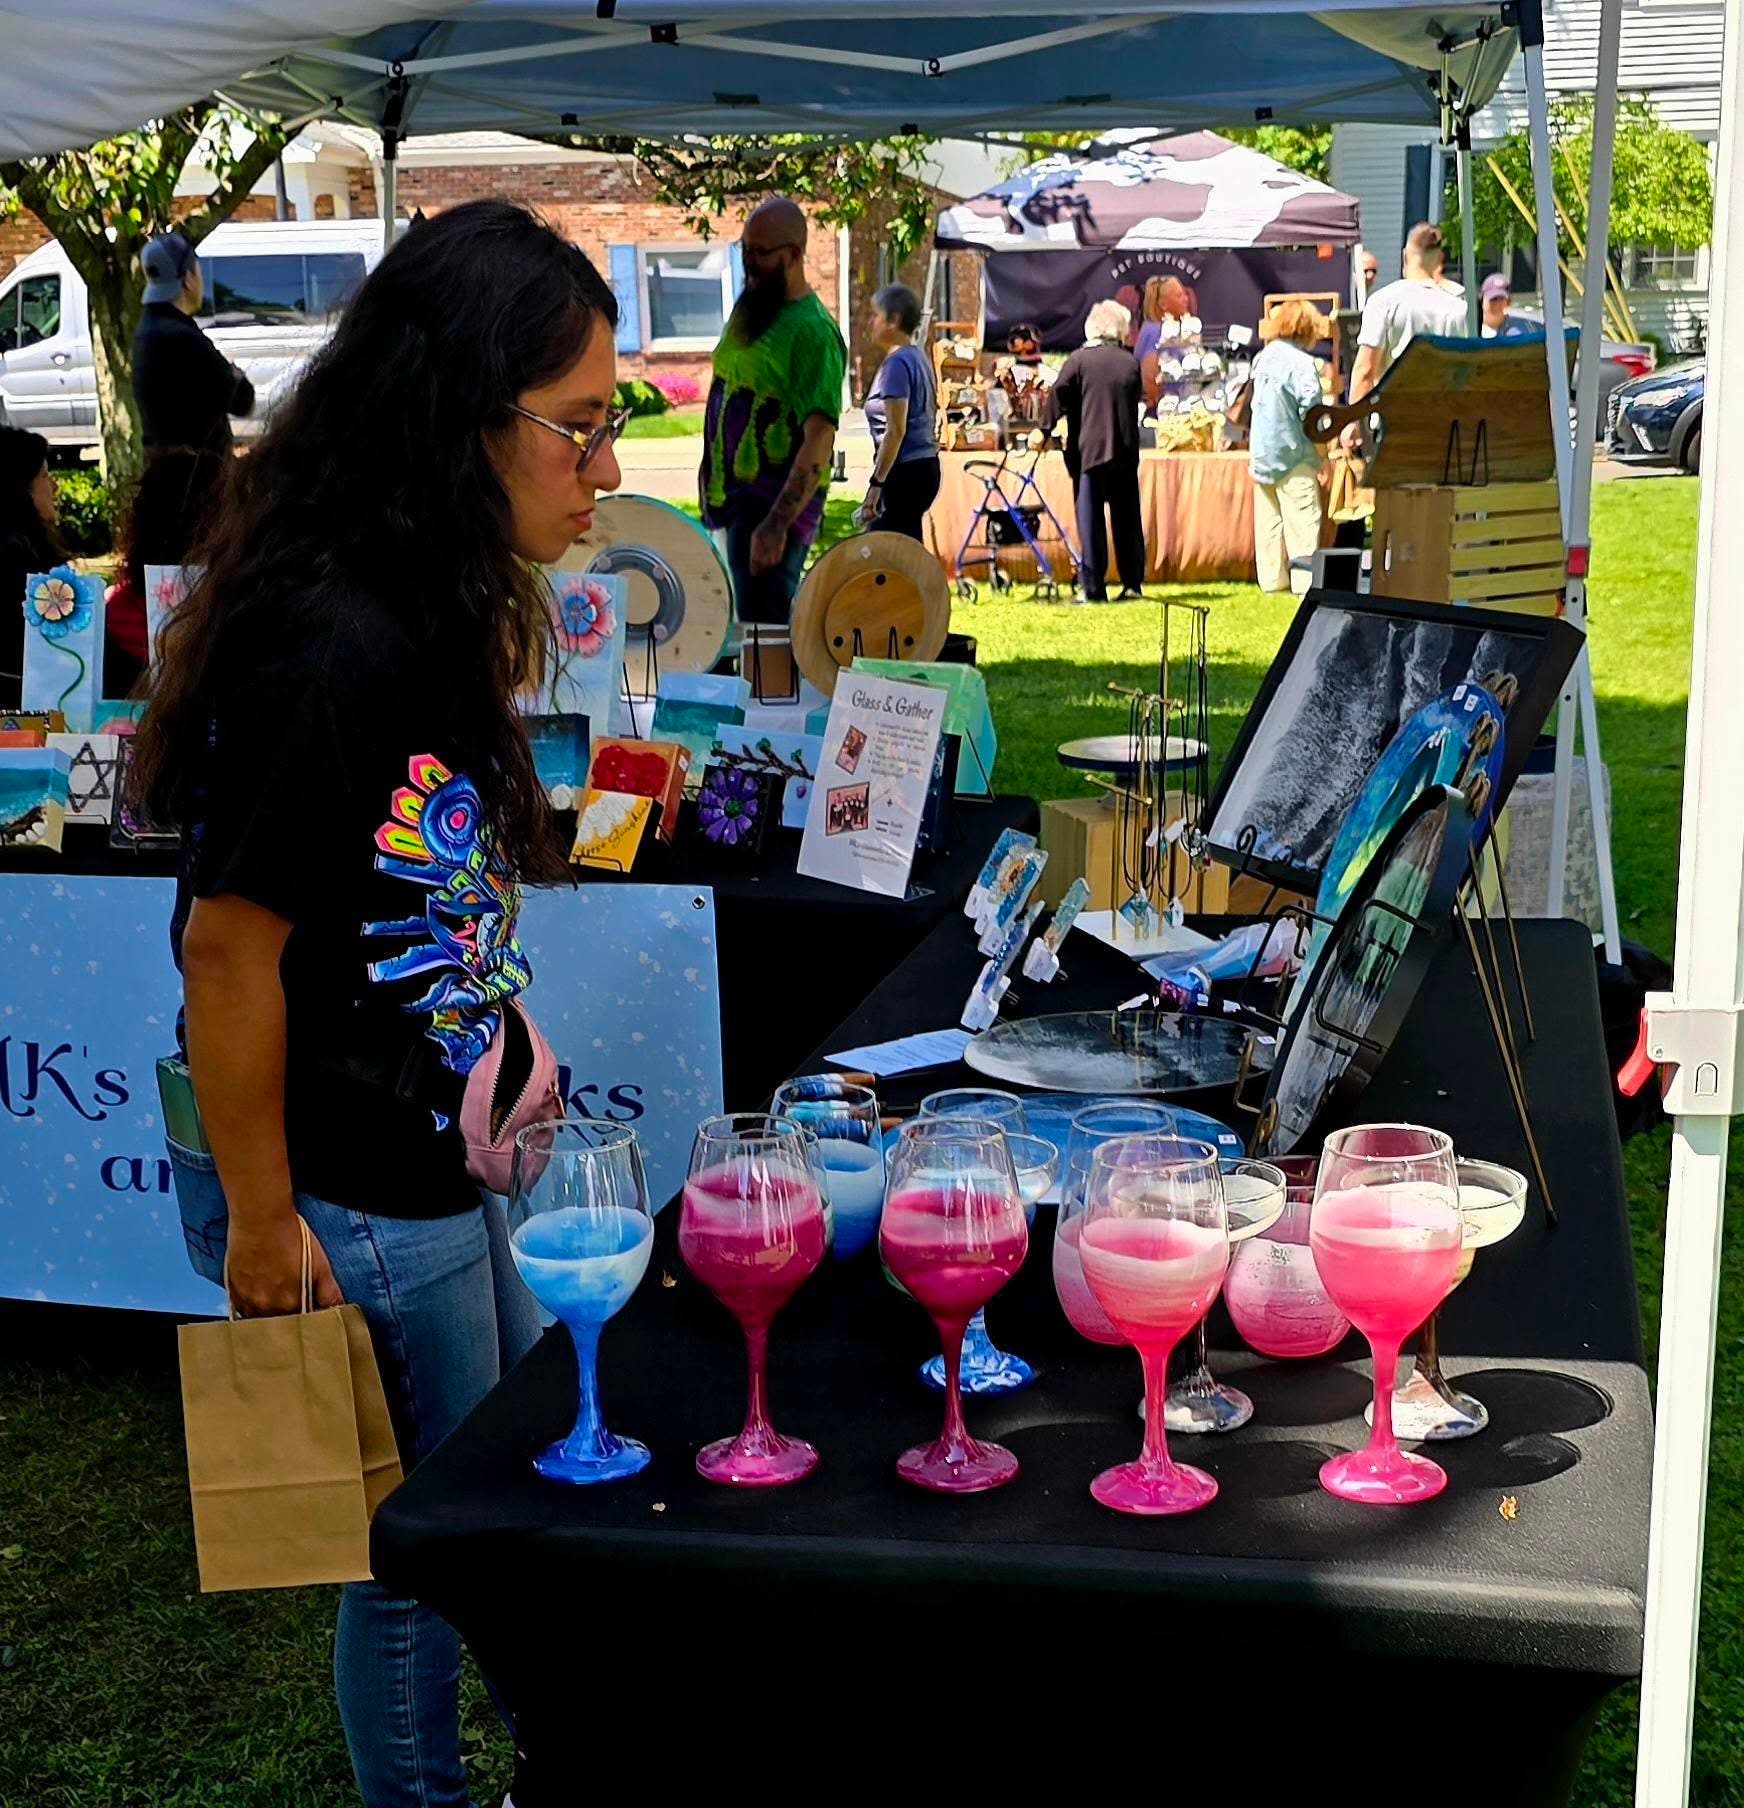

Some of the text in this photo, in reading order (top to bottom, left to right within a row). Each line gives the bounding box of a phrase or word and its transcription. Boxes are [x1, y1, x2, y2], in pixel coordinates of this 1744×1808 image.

[852, 689, 934, 720] Glass & Gather
[557, 1064, 645, 1121] ks
